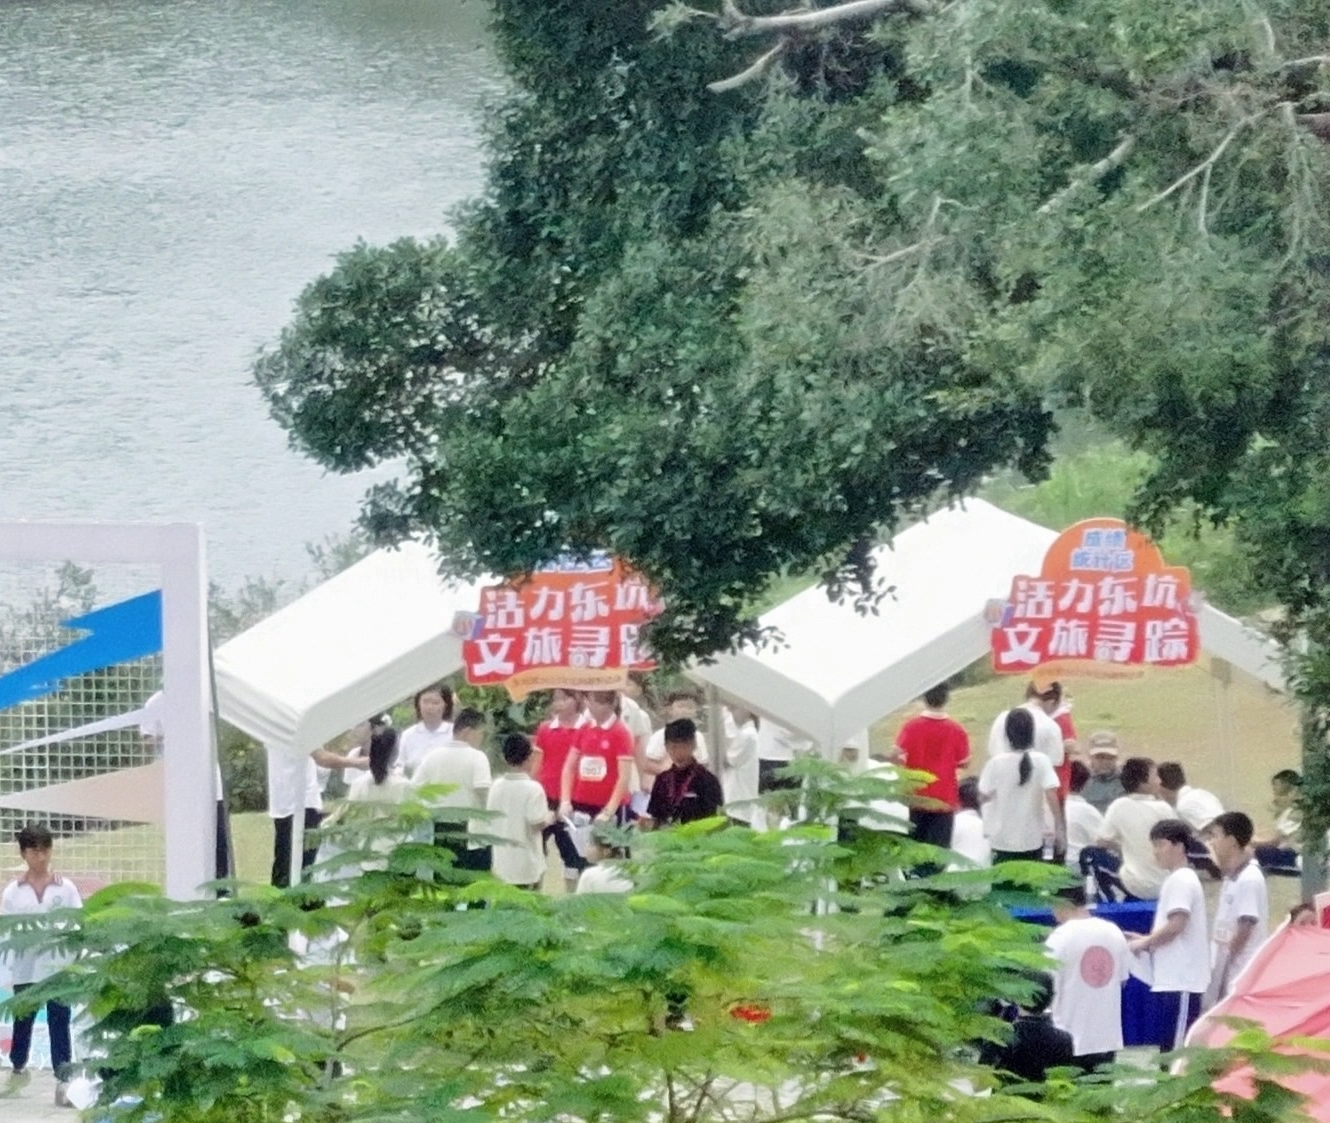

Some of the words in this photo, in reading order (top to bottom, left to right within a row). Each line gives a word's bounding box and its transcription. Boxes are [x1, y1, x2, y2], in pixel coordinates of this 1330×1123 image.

[483, 581, 650, 629] 活力东坑
[1013, 573, 1181, 619] 活力东坑
[1000, 617, 1189, 664] 文旅寻踪
